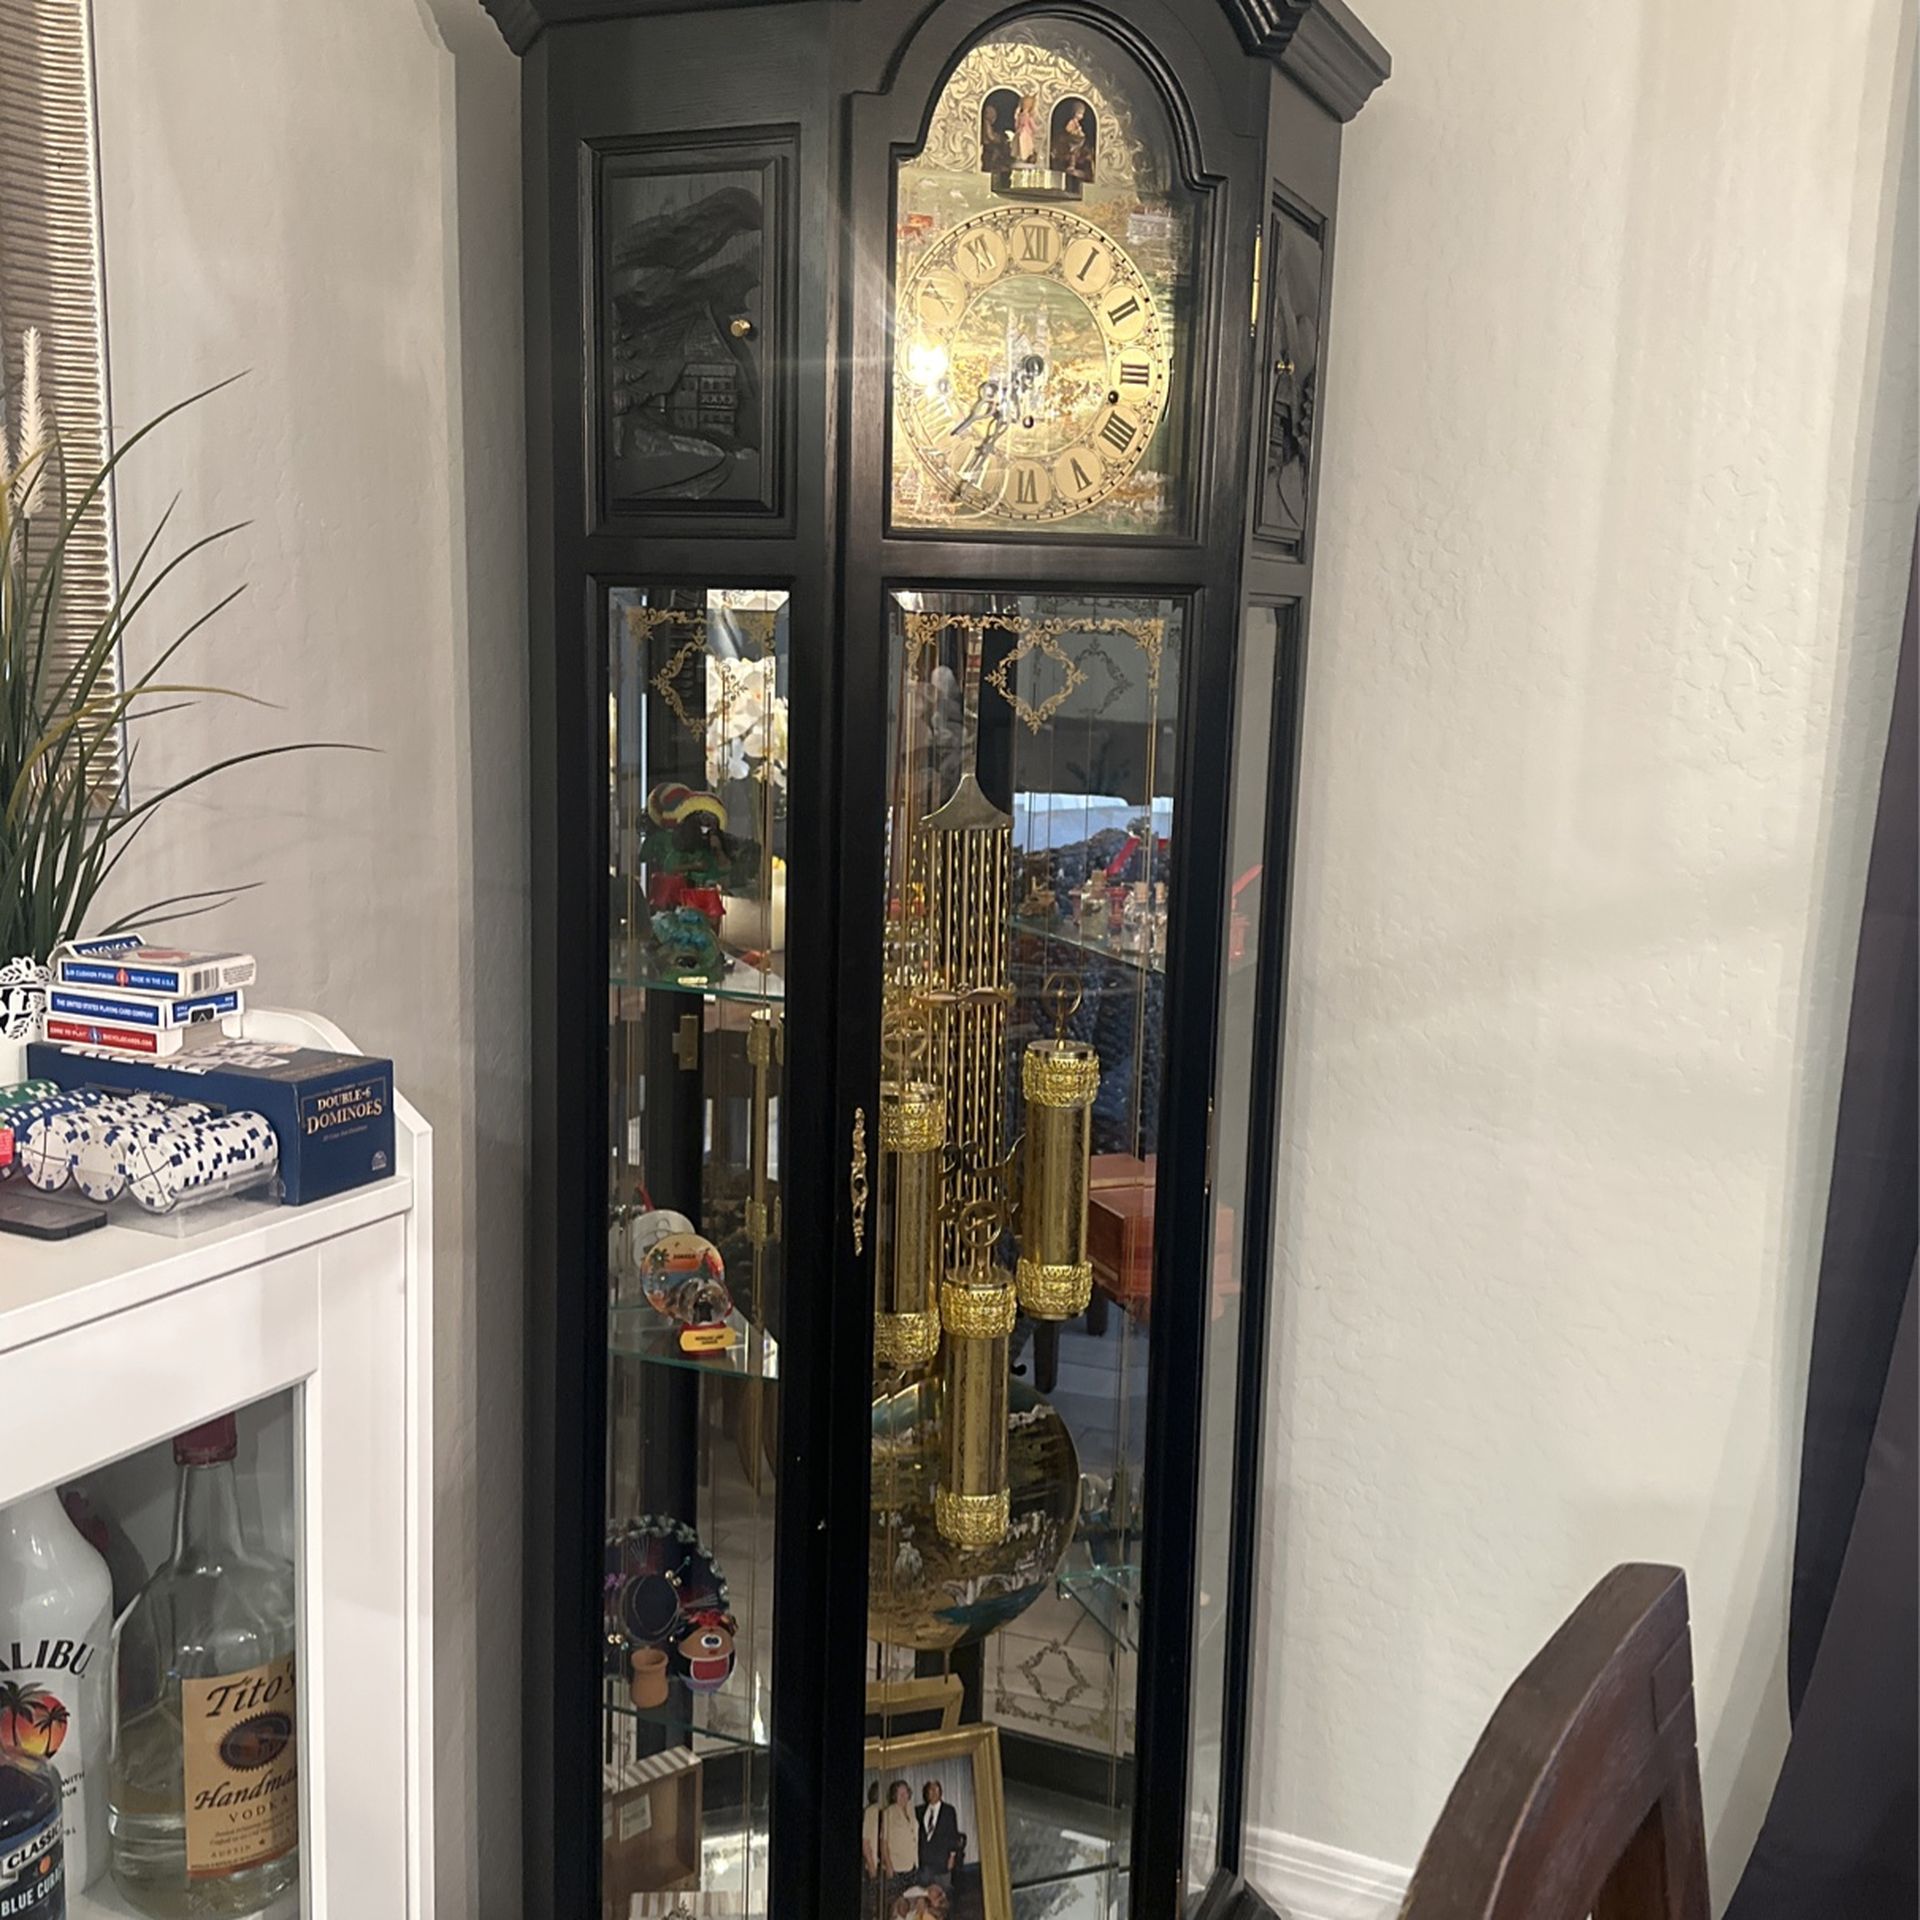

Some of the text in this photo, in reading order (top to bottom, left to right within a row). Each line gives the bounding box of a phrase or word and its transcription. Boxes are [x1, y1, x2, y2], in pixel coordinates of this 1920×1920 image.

[1021, 224, 1050, 263] XII
[1120, 360, 1150, 388] III
[66, 999, 82, 1009] UNITED
[83, 1001, 99, 1011] STATES
[100, 1004, 118, 1015] PLAYING
[119, 1007, 132, 1017] CARD
[132, 1008, 154, 1019] COMPANY
[317, 1086, 372, 1112] DOUBLE-6
[306, 1098, 383, 1135] DOMINOES
[194, 1768, 297, 1811] Handma
[229, 1794, 289, 1823] VODKA
[1, 1888, 34, 1918] BLUE
